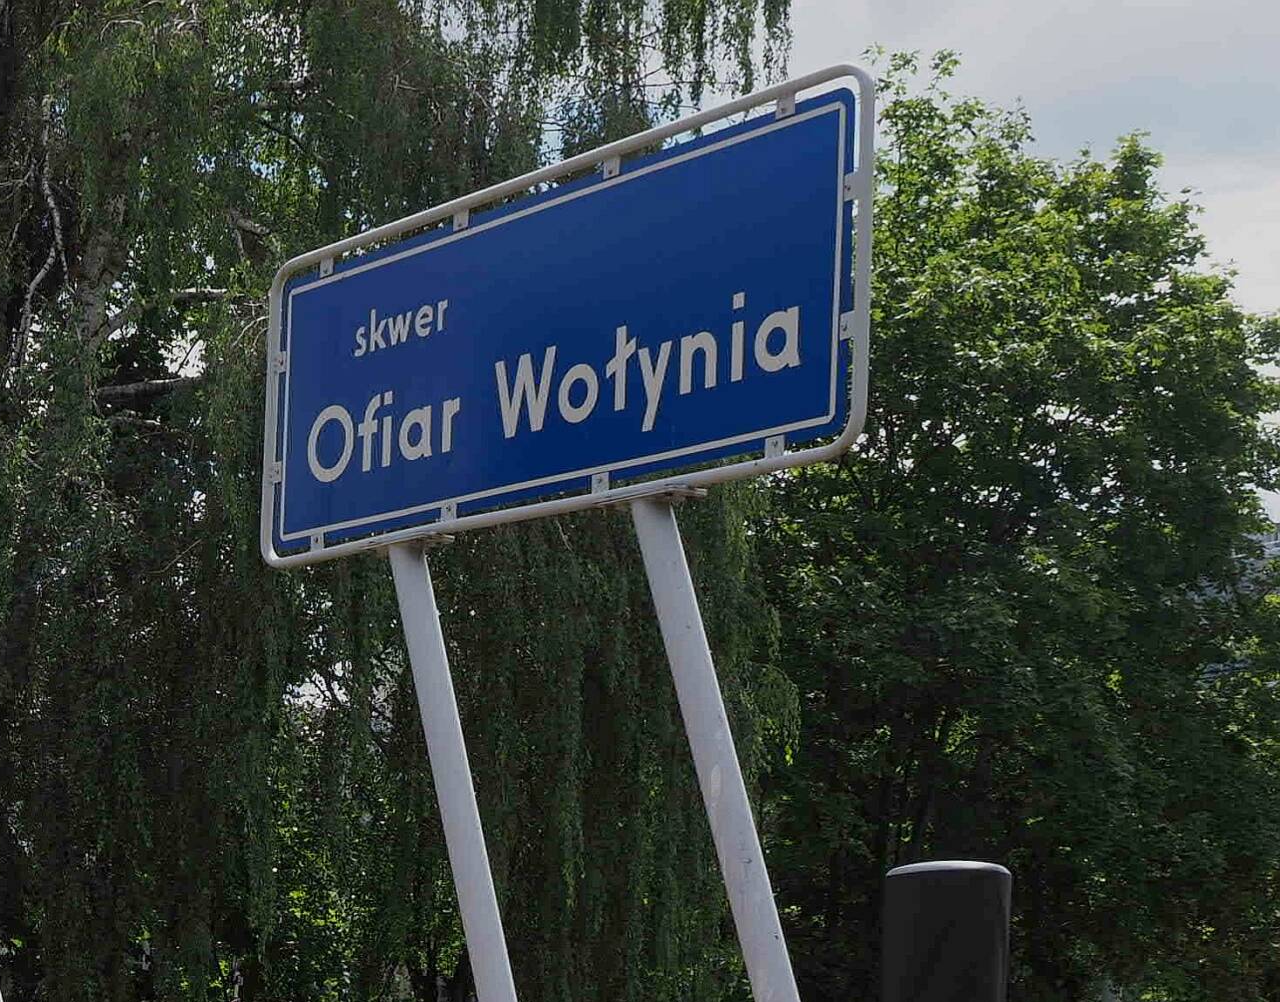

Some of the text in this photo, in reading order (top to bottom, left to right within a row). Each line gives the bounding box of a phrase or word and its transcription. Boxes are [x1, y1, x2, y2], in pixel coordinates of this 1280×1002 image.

[307, 292, 801, 483] Ofiar Wołynia
[353, 298, 449, 358] skwer
